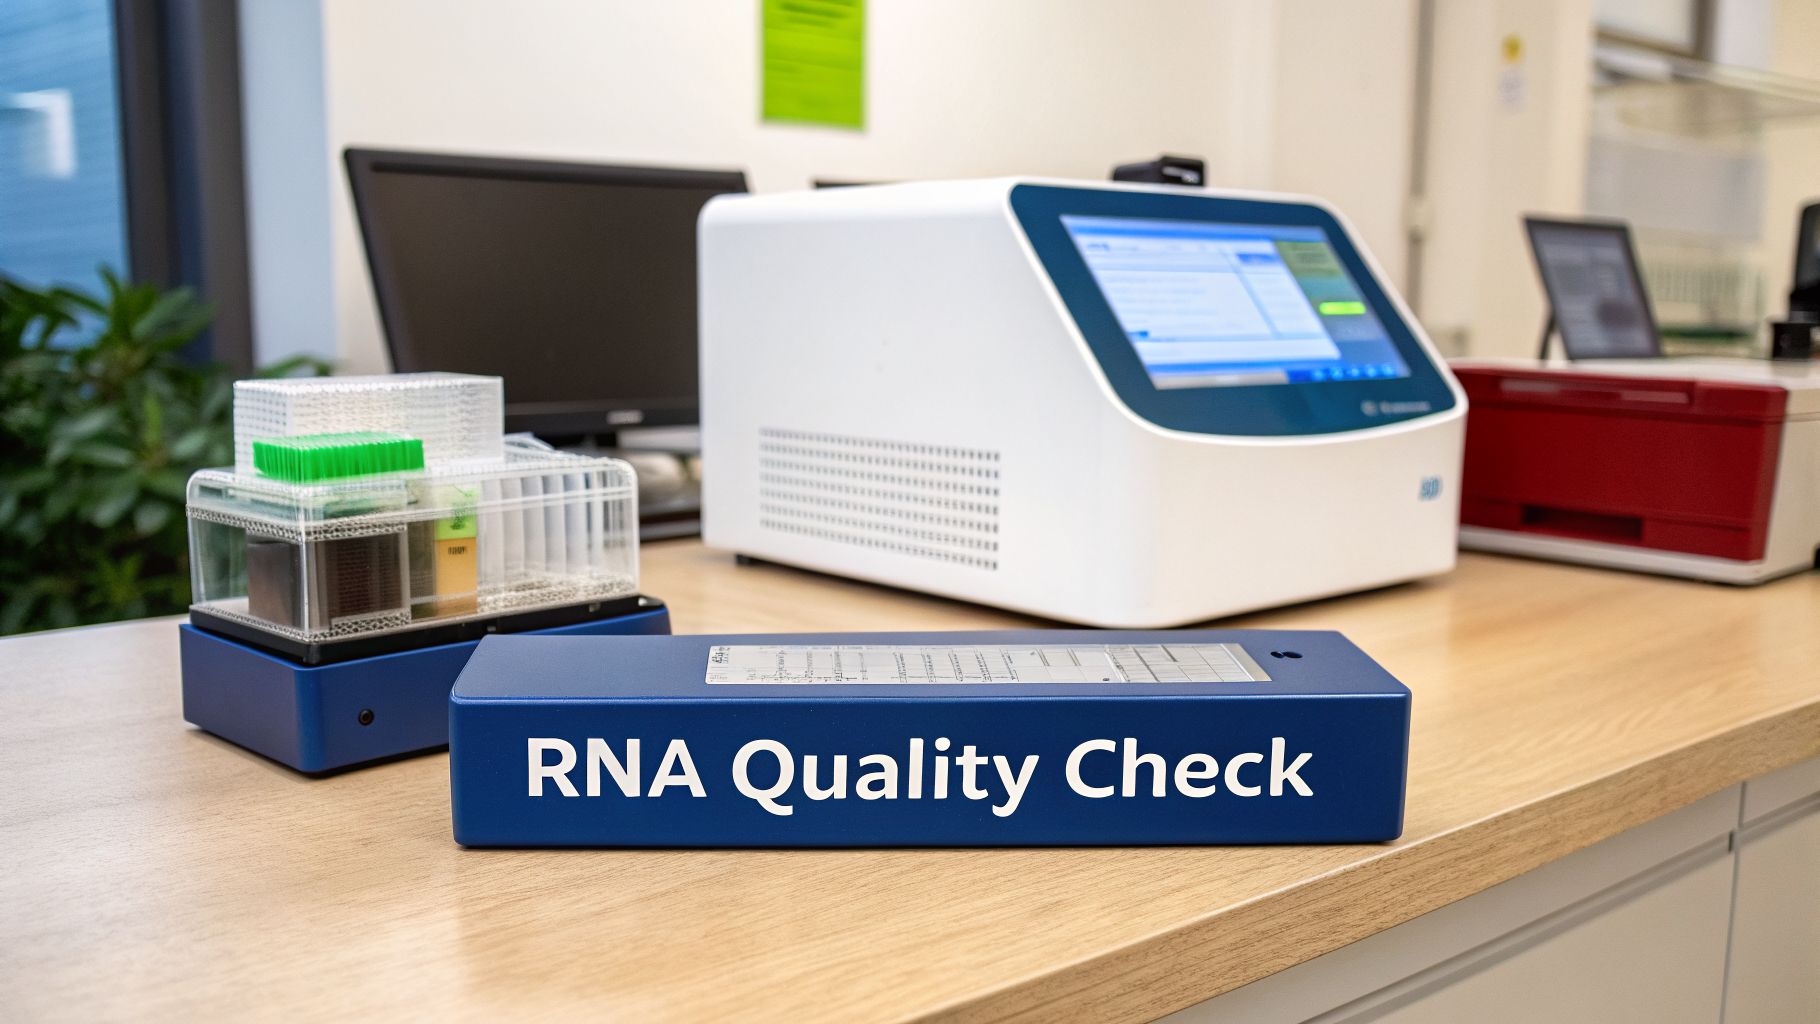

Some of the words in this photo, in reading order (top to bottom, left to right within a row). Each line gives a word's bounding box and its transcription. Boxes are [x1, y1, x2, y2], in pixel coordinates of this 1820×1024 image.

[527, 737, 707, 798] RNA
[732, 737, 1040, 816] Quality
[1065, 737, 1314, 799] Check
